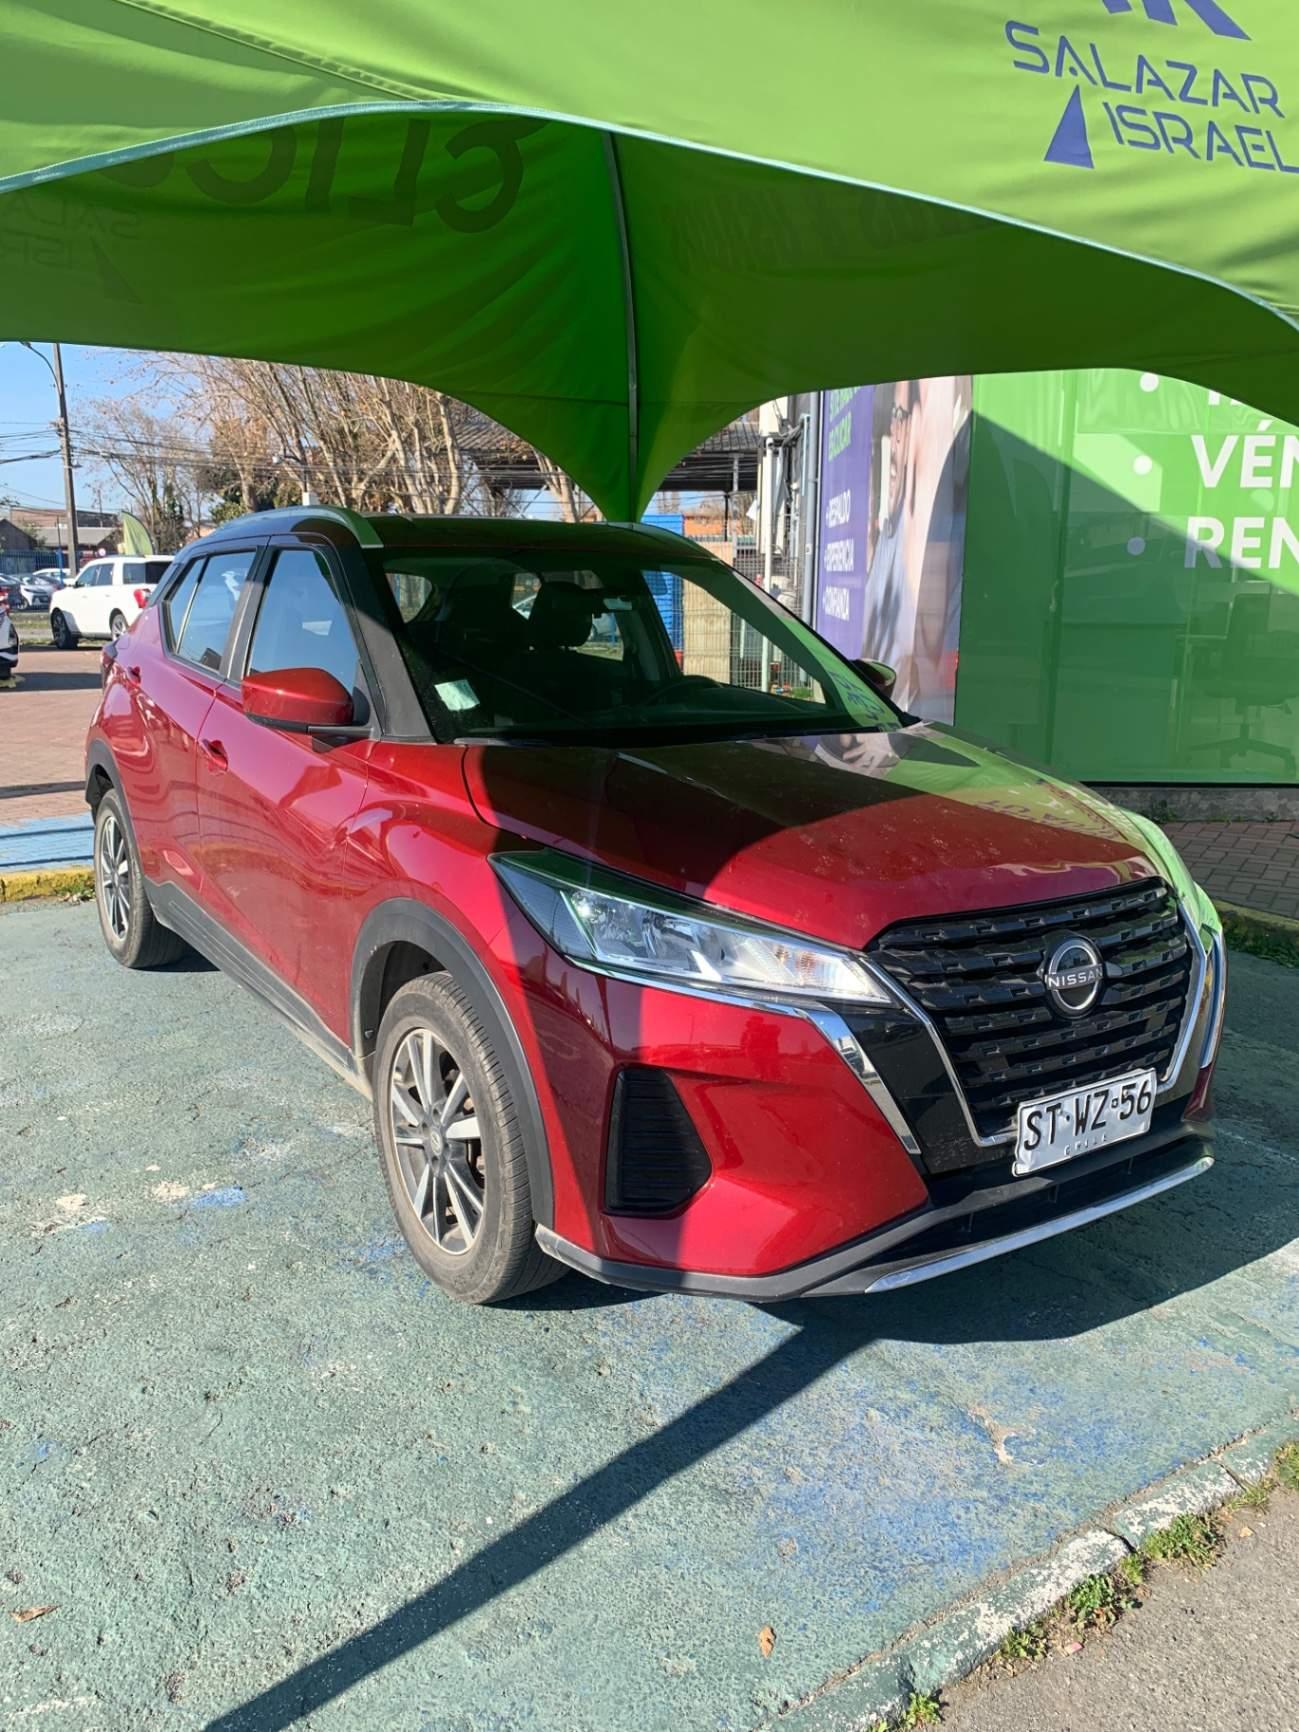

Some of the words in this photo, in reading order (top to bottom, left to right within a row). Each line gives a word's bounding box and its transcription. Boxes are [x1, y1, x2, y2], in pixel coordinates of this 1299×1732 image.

[1004, 19, 1286, 119] SALAZAR
[1101, 101, 1299, 174] ISRAEL
[1048, 966, 1103, 988] NISSAN
